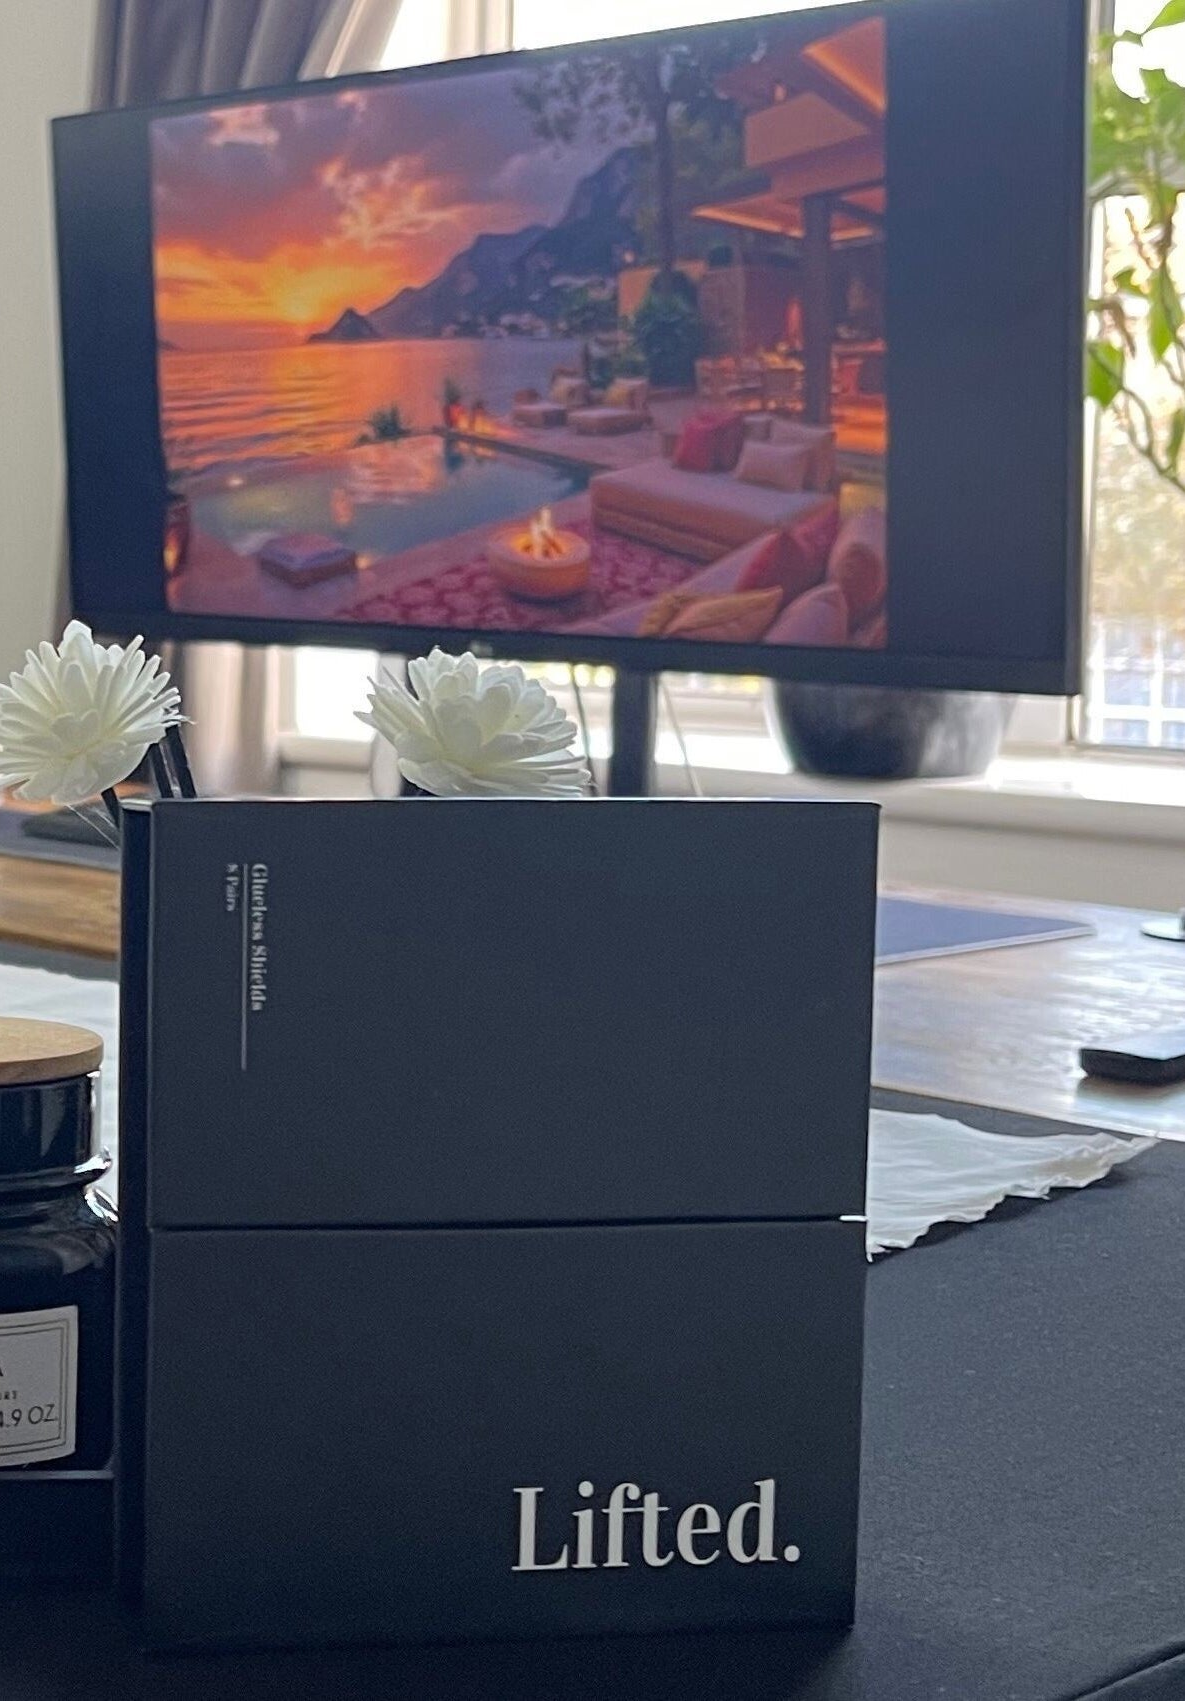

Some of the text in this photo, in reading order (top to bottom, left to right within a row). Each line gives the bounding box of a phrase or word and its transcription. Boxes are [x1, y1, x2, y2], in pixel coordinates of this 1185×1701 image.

[226, 876, 239, 912] Pairs
[250, 863, 268, 1011] Glueless Shields
[511, 1478, 801, 1571] Lifted.
